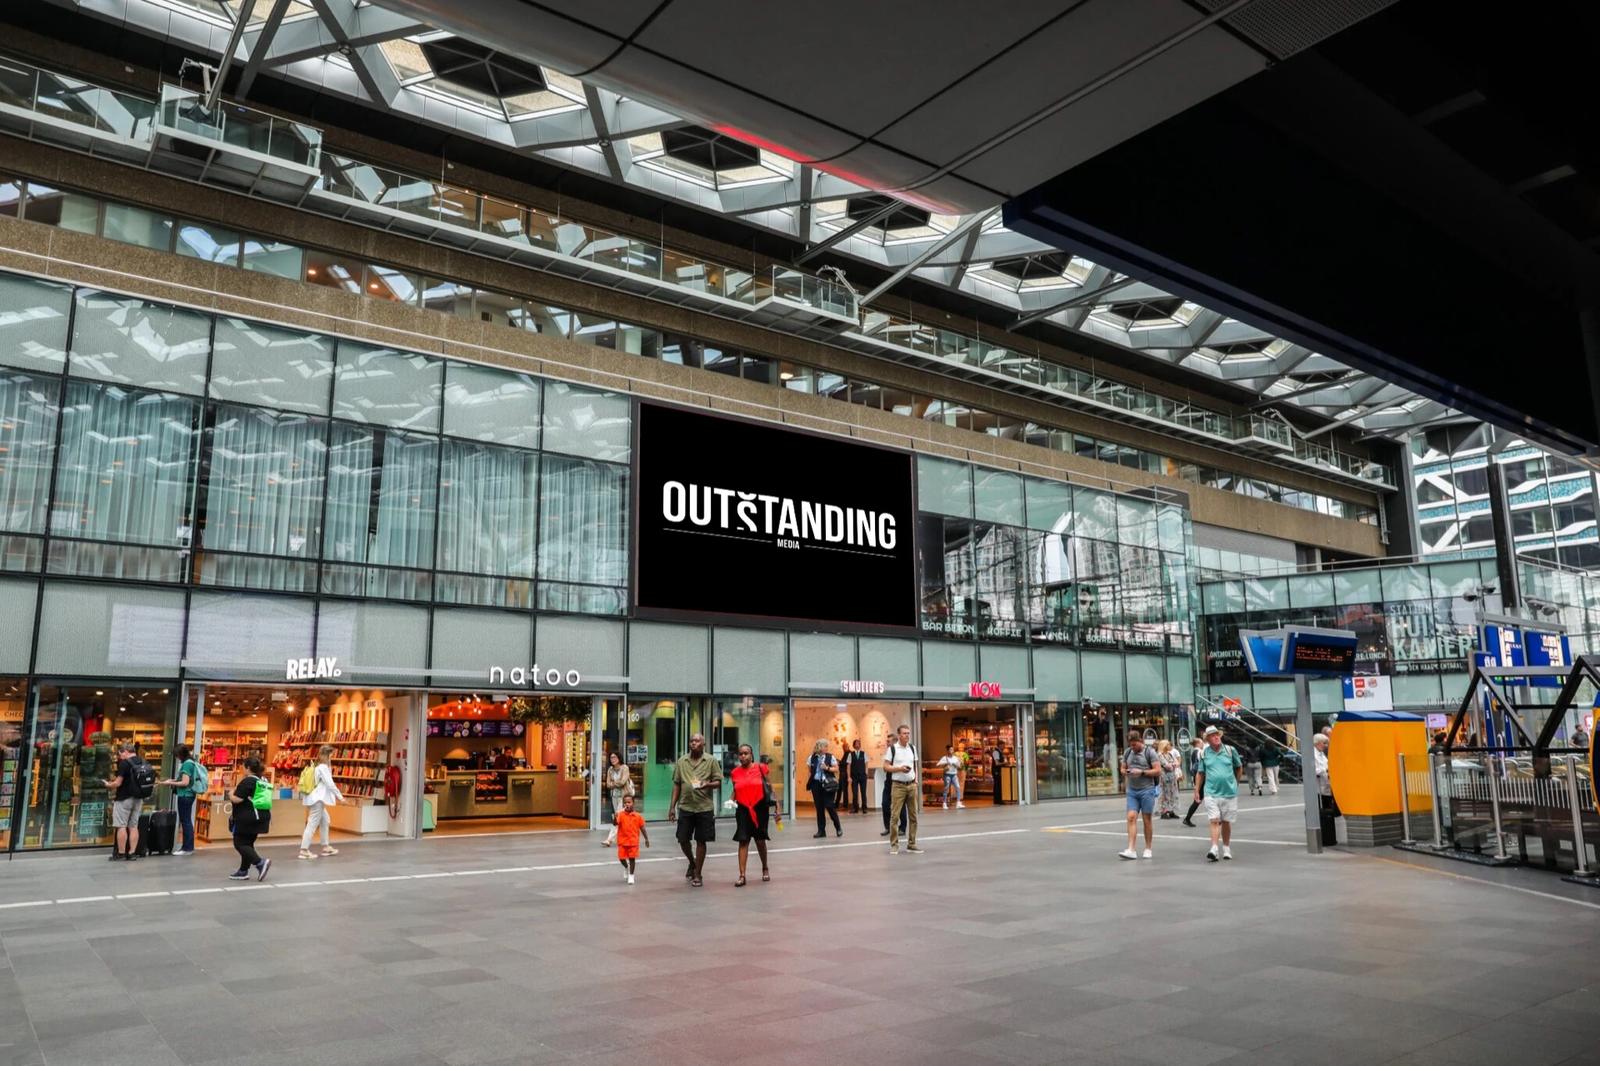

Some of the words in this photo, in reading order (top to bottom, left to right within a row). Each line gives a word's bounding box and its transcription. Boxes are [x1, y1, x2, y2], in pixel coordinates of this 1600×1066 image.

[662, 480, 897, 550] OUTSTANDING
[777, 538, 800, 550] MEDIA
[922, 620, 943, 632] BAR
[286, 657, 337, 680] RELAY
[489, 664, 581, 686] natoo
[968, 680, 1002, 698] KIOSK
